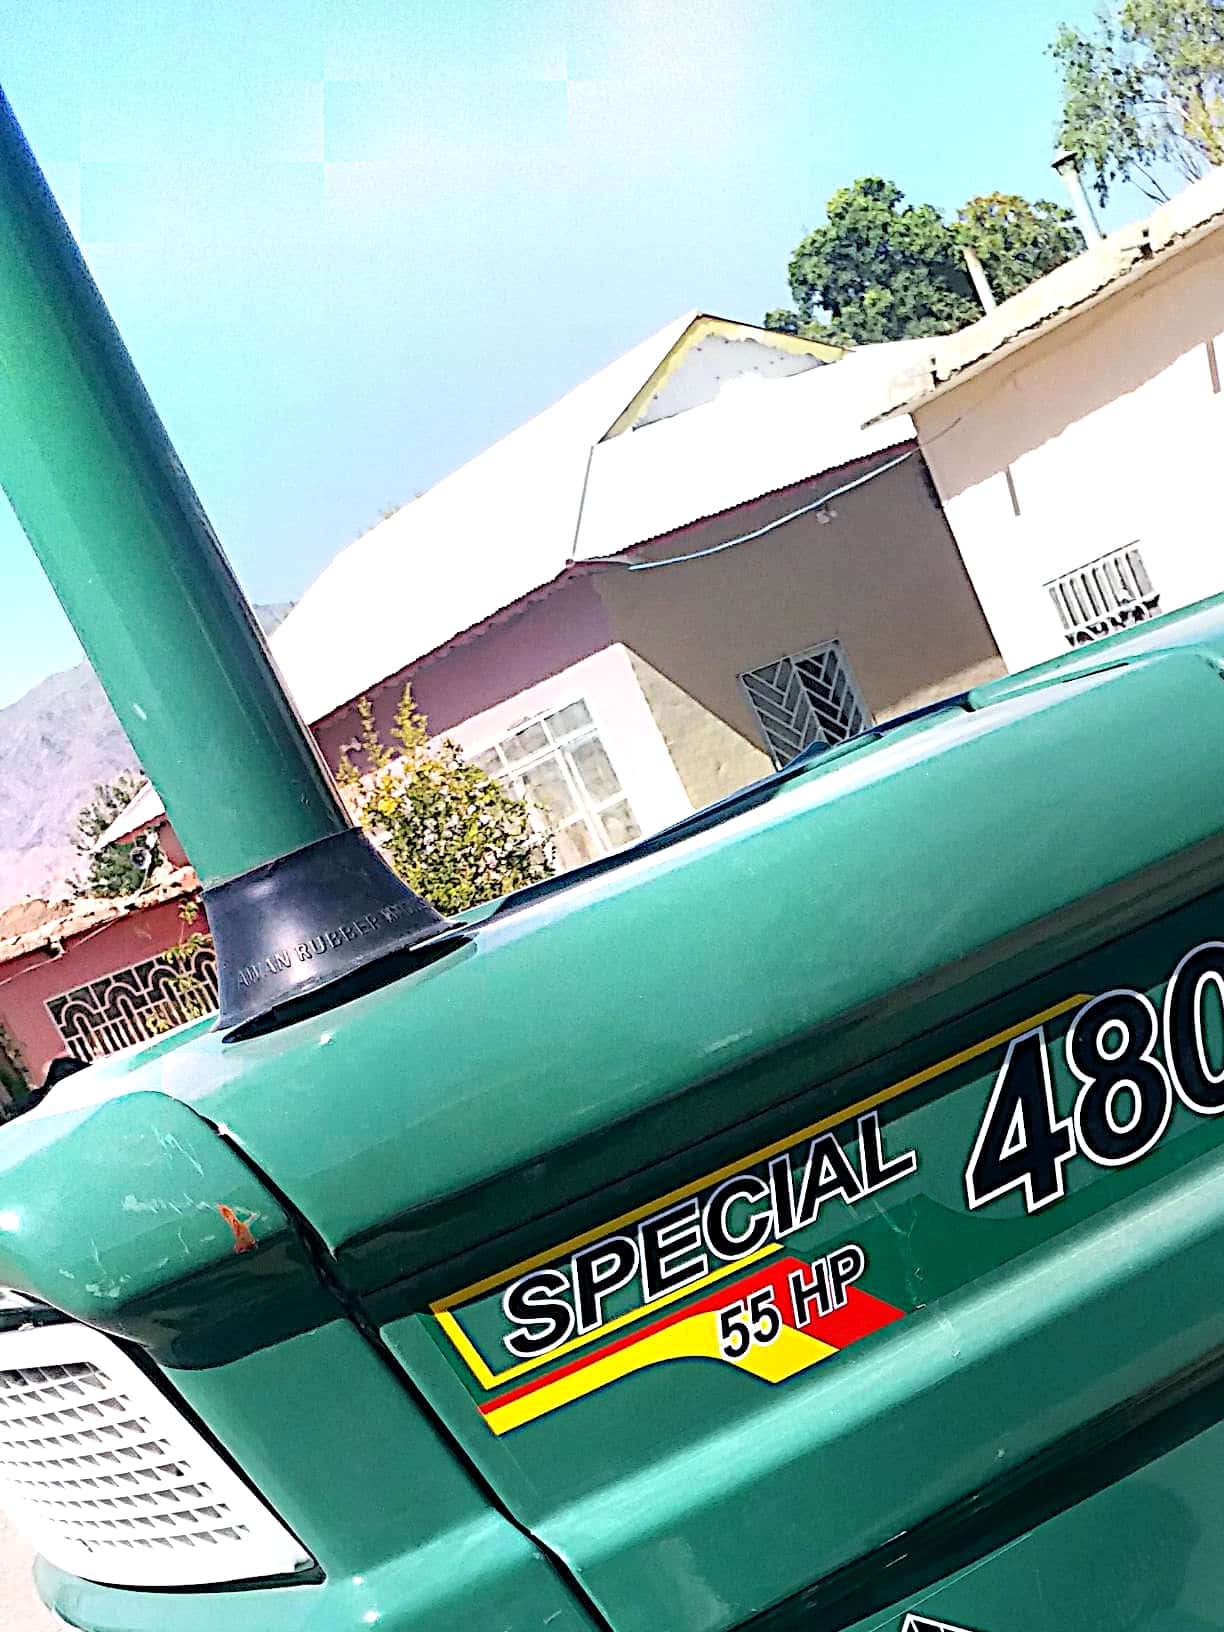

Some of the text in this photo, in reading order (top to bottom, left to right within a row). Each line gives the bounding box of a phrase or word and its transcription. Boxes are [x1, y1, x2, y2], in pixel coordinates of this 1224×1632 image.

[296, 912, 379, 962] RUBBER
[502, 1112, 918, 1358] SPECIAL
[718, 1243, 866, 1361] 55 HP
